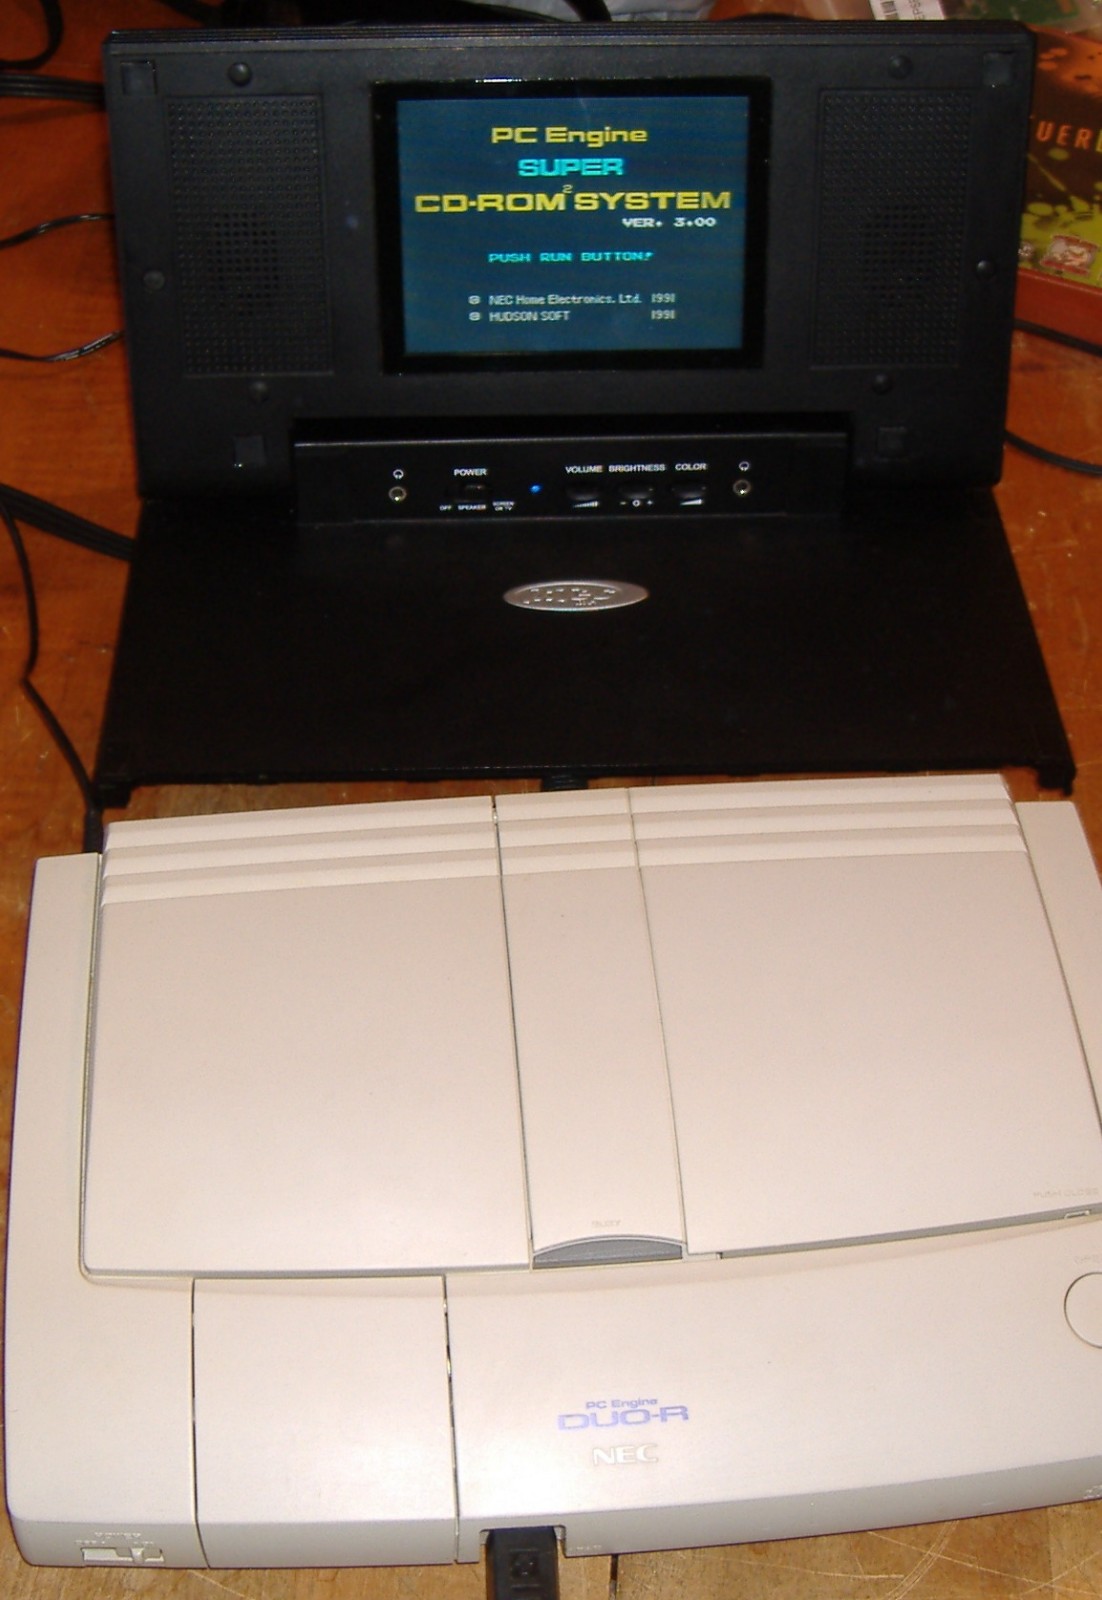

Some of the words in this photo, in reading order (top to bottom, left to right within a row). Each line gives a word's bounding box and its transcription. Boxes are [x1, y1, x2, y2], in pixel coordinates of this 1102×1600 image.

[491, 127, 538, 144] PC
[545, 126, 648, 148] Engine
[1035, 121, 1102, 151] UER
[517, 158, 624, 177] SUPER
[574, 191, 731, 211] SYSTEM
[488, 253, 532, 263] PUSH
[539, 252, 573, 262] RUN
[489, 295, 513, 306] NEC
[516, 295, 546, 305] Home
[651, 293, 676, 303] 1991
[489, 310, 538, 322] HUDSON
[540, 310, 571, 321] SOFT
[651, 310, 676, 320] 1991
[453, 468, 488, 477] POWER
[565, 464, 603, 474] VOLUME
[608, 463, 667, 473] BRIGHTNESS
[674, 462, 707, 471] COLOR
[585, 1400, 607, 1409] PC
[611, 1398, 658, 1408] Engine
[558, 1406, 689, 1430] DUO-R
[593, 1444, 659, 1466] NEC
